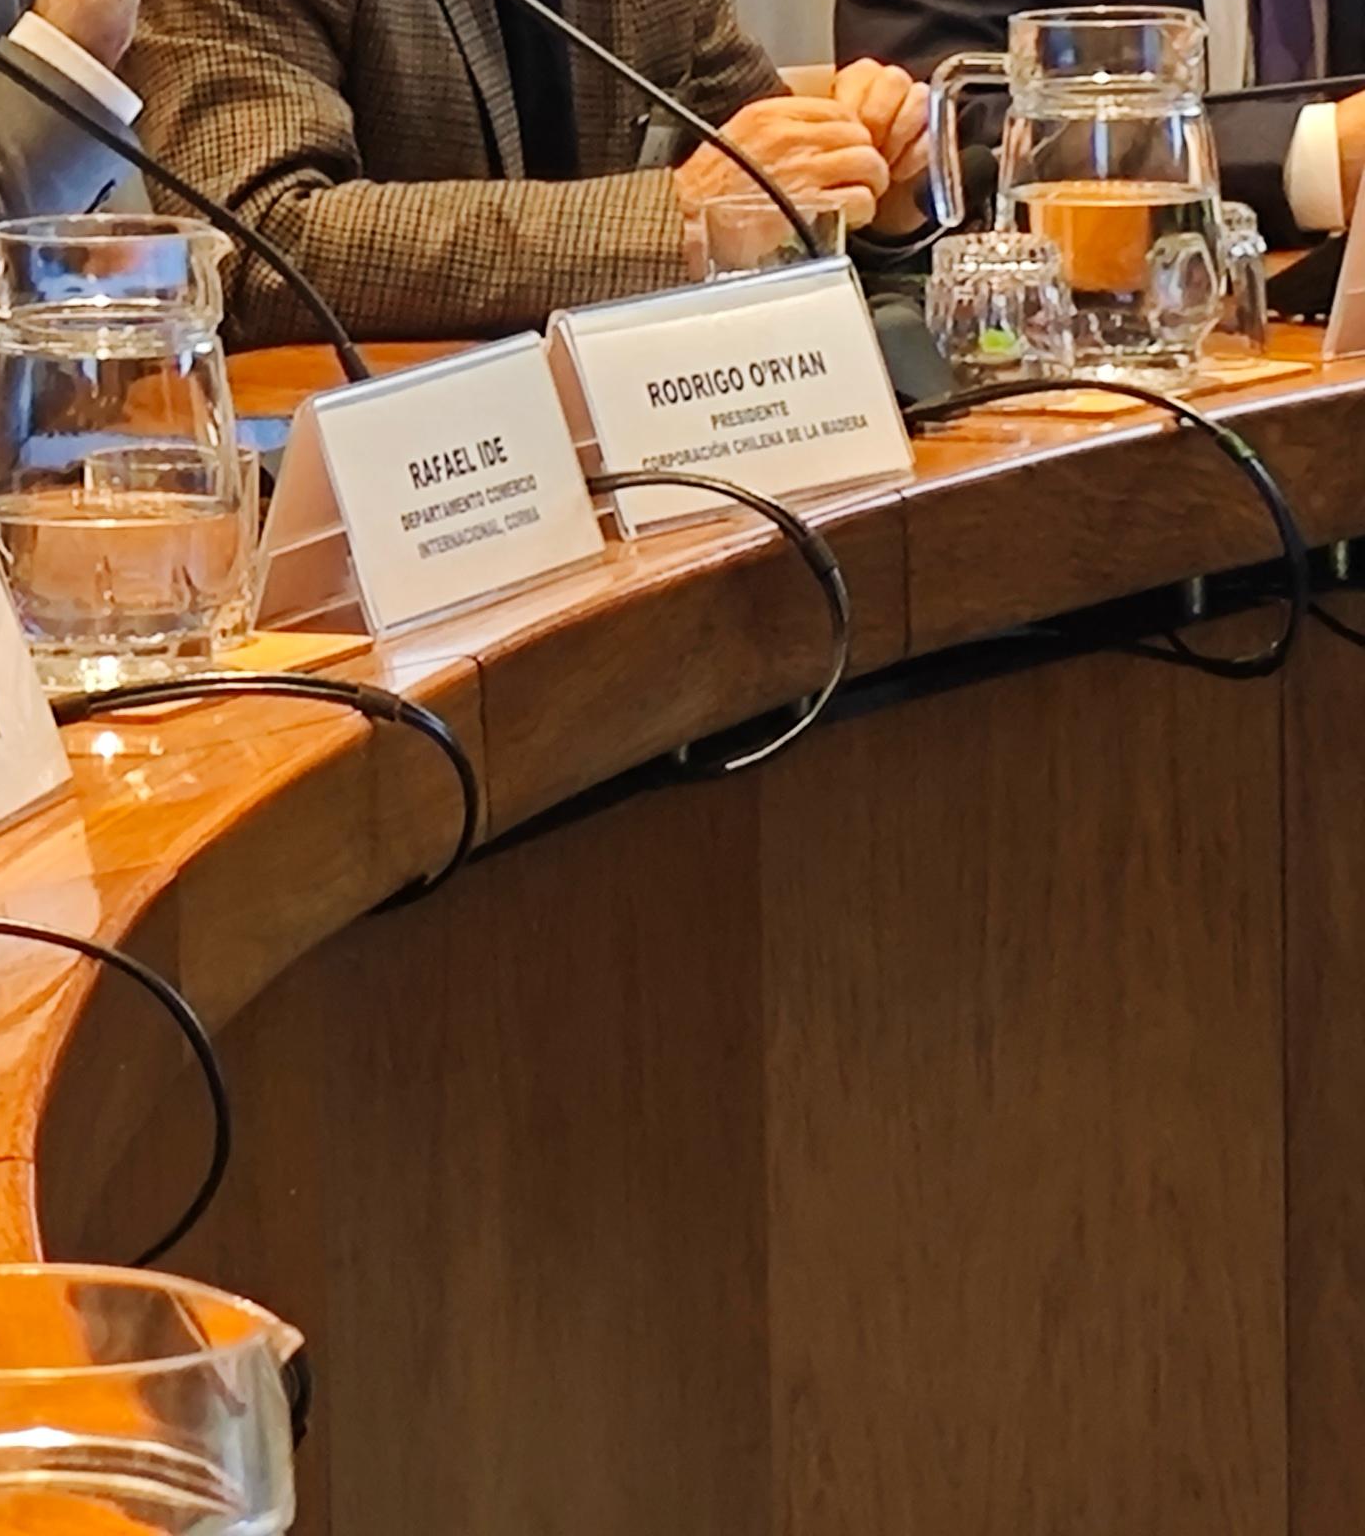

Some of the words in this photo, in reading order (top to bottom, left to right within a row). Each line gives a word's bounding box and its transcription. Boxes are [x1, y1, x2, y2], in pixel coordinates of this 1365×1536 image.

[647, 366, 744, 408] RODRIGO
[749, 350, 827, 387] O'RYAN
[710, 400, 790, 430] PRESIDENTE
[732, 430, 785, 455] CHILENA
[785, 425, 803, 443] DE
[803, 422, 820, 440] LA
[820, 414, 869, 436] MADERA
[408, 446, 477, 490] RAFAEL
[476, 436, 508, 469] IDE
[400, 490, 485, 532] DEPARTAMENTO
[485, 473, 537, 504] COMERCIO
